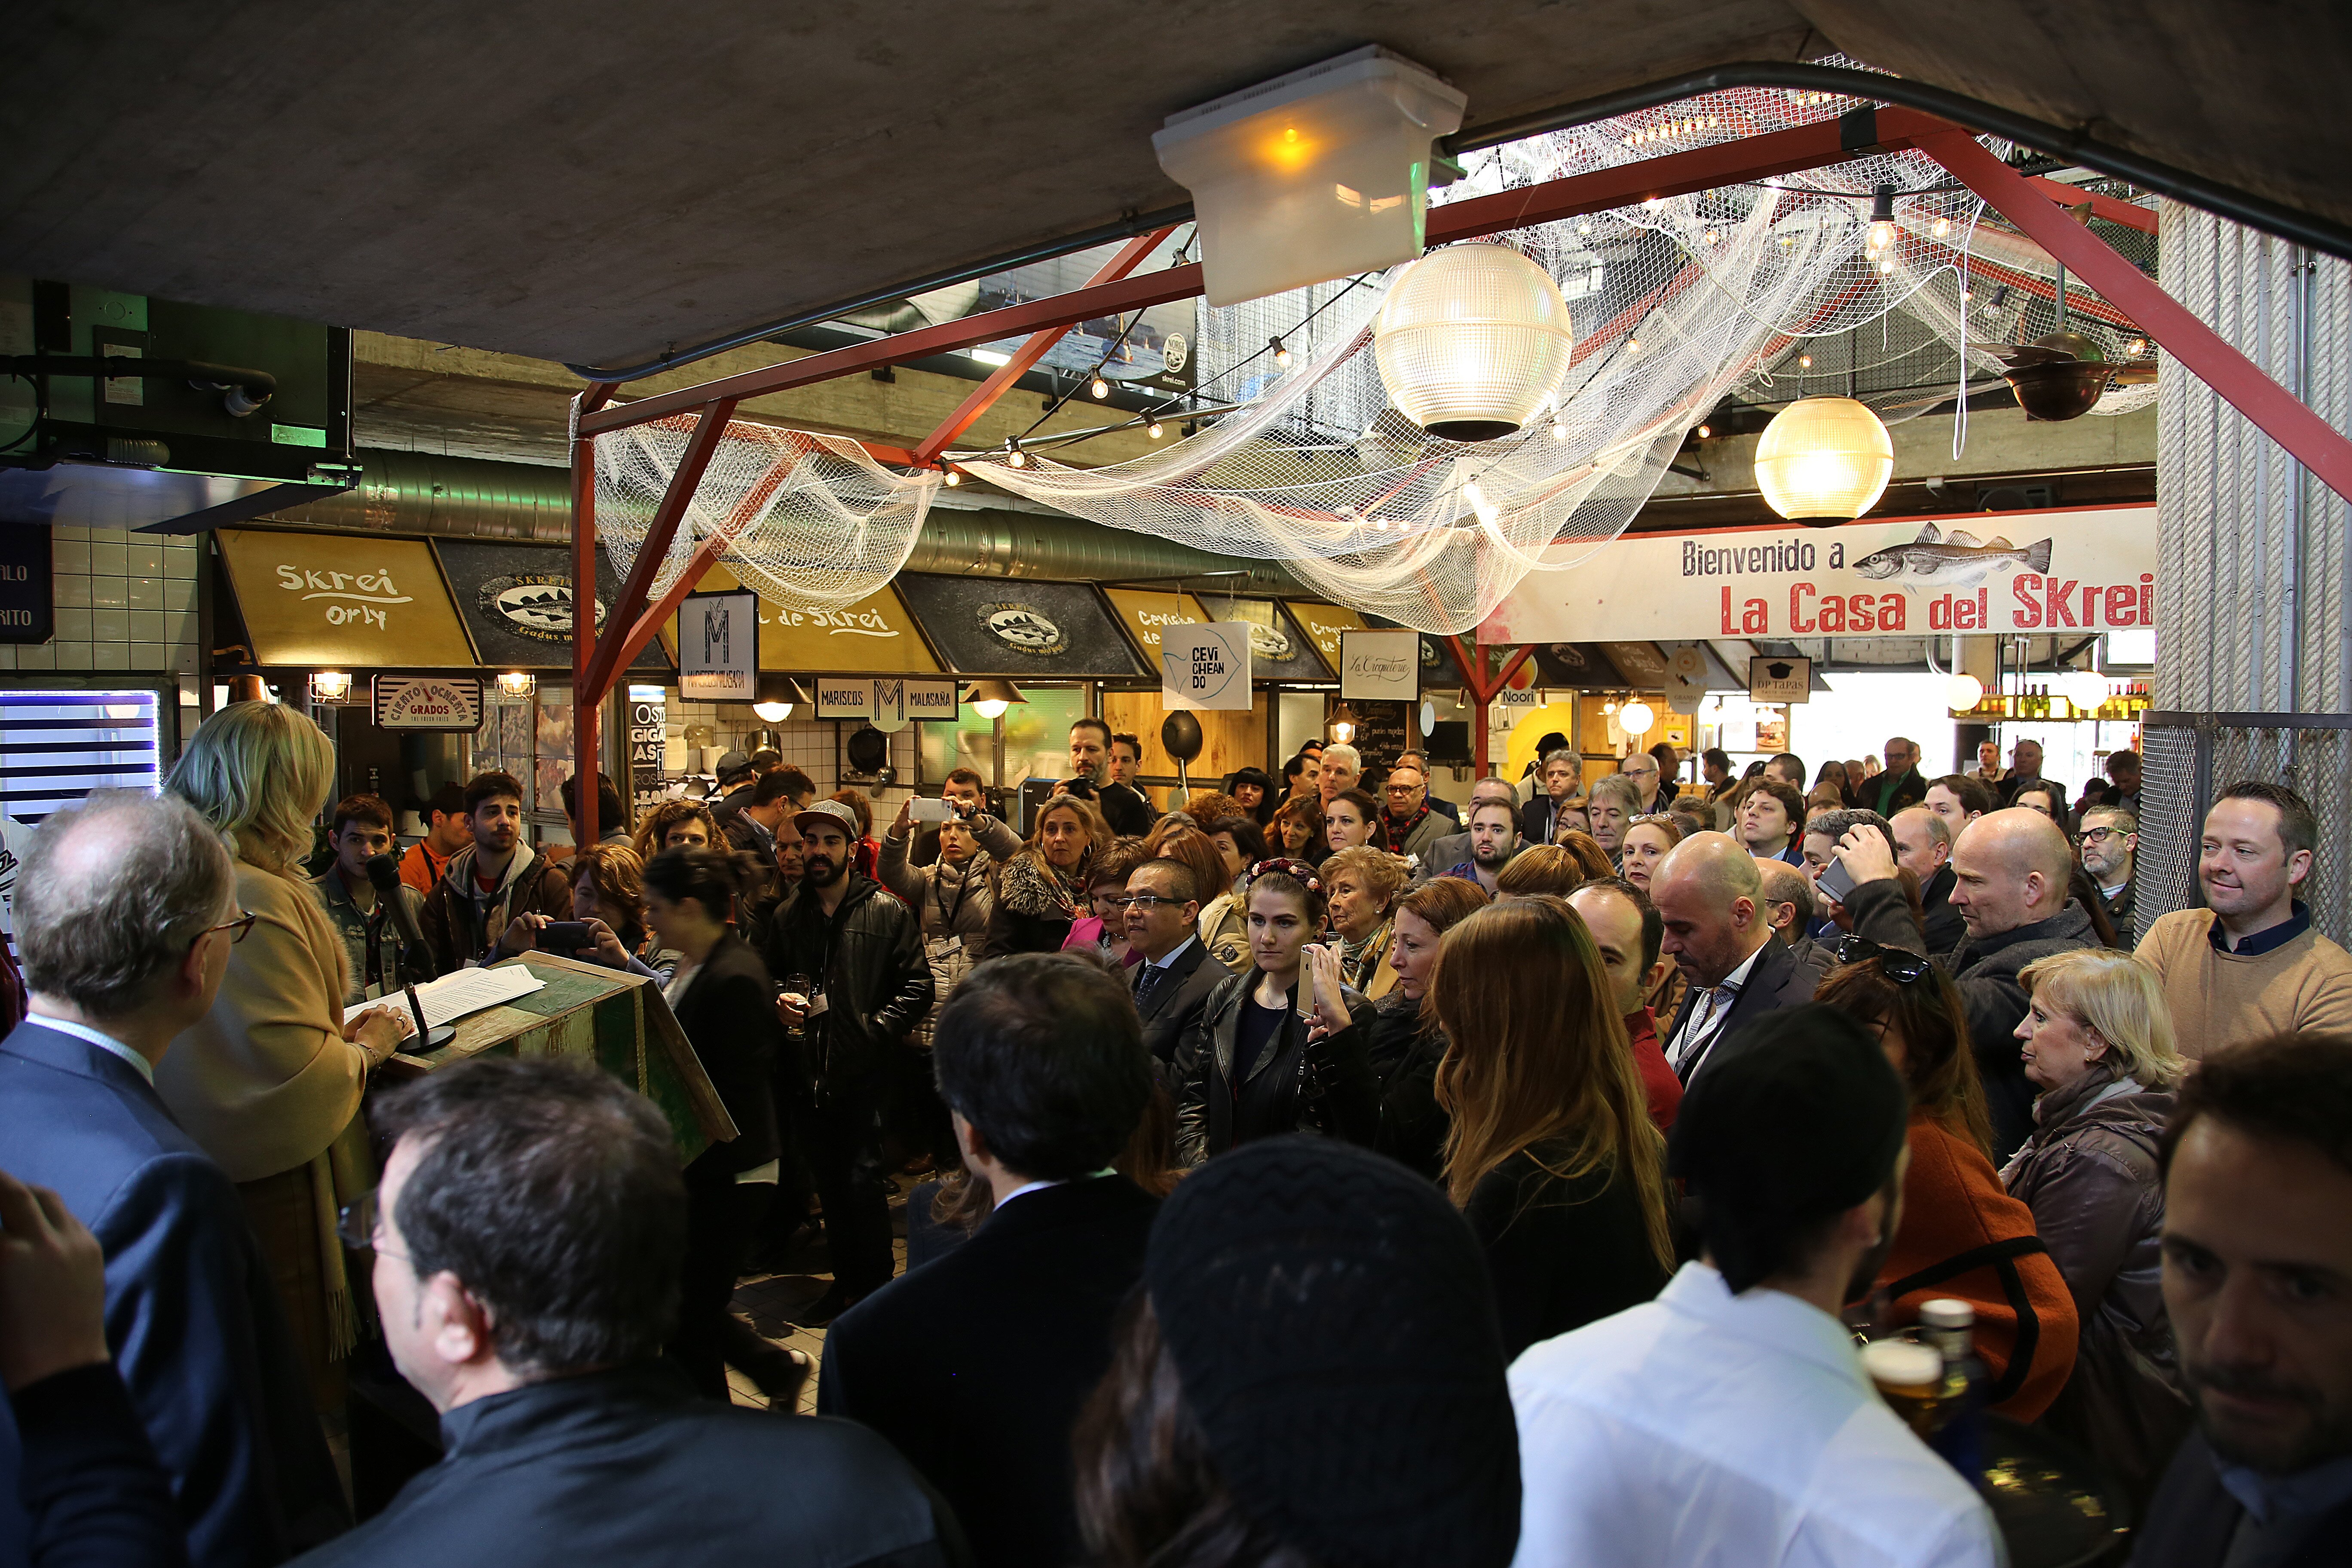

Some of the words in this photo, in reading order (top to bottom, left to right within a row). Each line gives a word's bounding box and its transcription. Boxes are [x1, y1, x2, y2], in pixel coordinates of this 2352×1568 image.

[1682, 539, 1815, 576] Bienvenido
[1829, 542, 1844, 569] a
[276, 564, 398, 595] Skrei
[1721, 586, 1768, 635] La
[1790, 582, 1906, 634] Casa
[1929, 587, 1988, 629] del
[2012, 573, 2153, 628] Skrei
[778, 609, 804, 626] de
[807, 606, 889, 630] Skrei
[518, 626, 559, 640] Gadus
[1142, 630, 1161, 645] de
[1321, 640, 1335, 652] de
[1192, 662, 1224, 674] CHEAN
[1192, 675, 1206, 689] DO
[391, 687, 421, 721] CIENTO
[430, 685, 468, 722] OCHENTA
[821, 690, 863, 705] MARISCOS
[910, 691, 950, 706] MALASAÑA
[1503, 691, 1534, 702] Noori
[410, 704, 450, 714] GRADOS
[633, 744, 657, 760] AS
